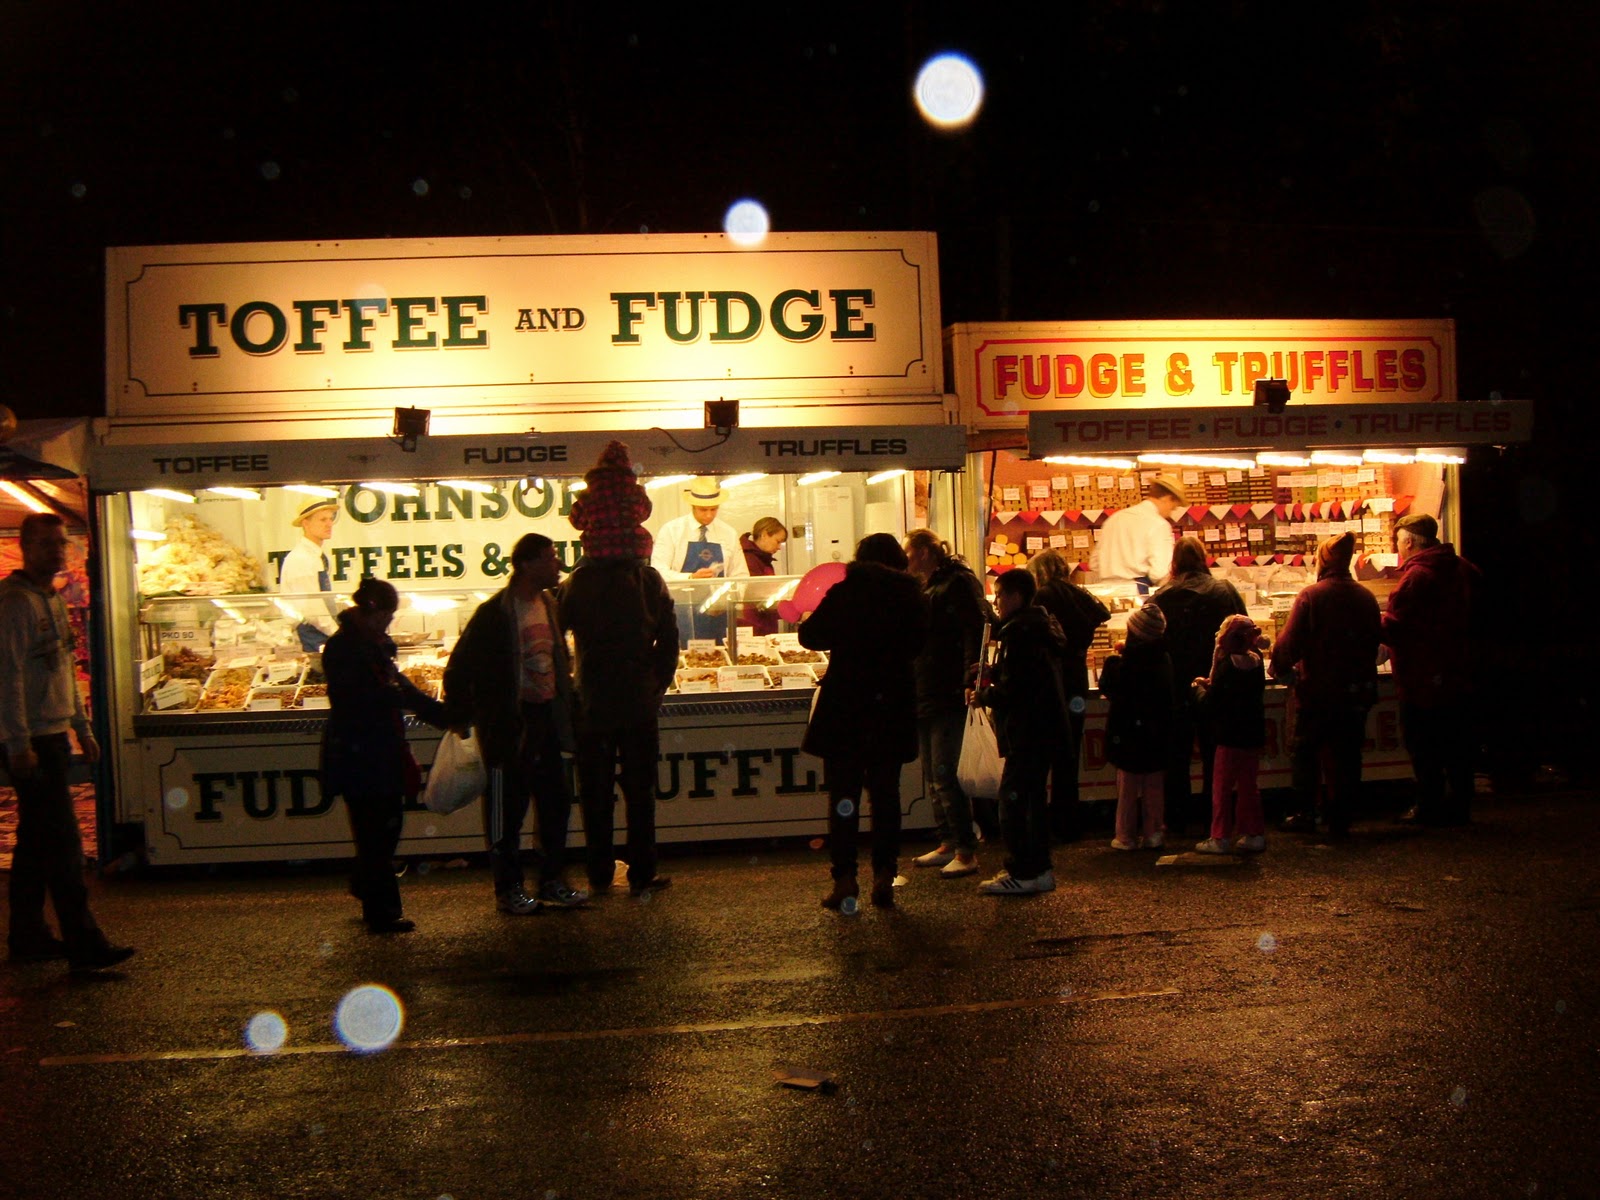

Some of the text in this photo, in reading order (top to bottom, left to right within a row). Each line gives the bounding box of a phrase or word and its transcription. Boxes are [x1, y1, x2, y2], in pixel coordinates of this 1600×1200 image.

[178, 287, 877, 358] TOFFEE AND FUDGE
[991, 347, 1428, 399] FUDGE & TRUFFLES
[1054, 410, 1512, 443] TOFFEE FUDGE TRUFFLES
[152, 437, 908, 475] TOFFEE FUDGE TRUFFLES
[336, 479, 582, 524] OHNSO
[268, 543, 465, 585] TFFEES
[481, 541, 512, 580] &
